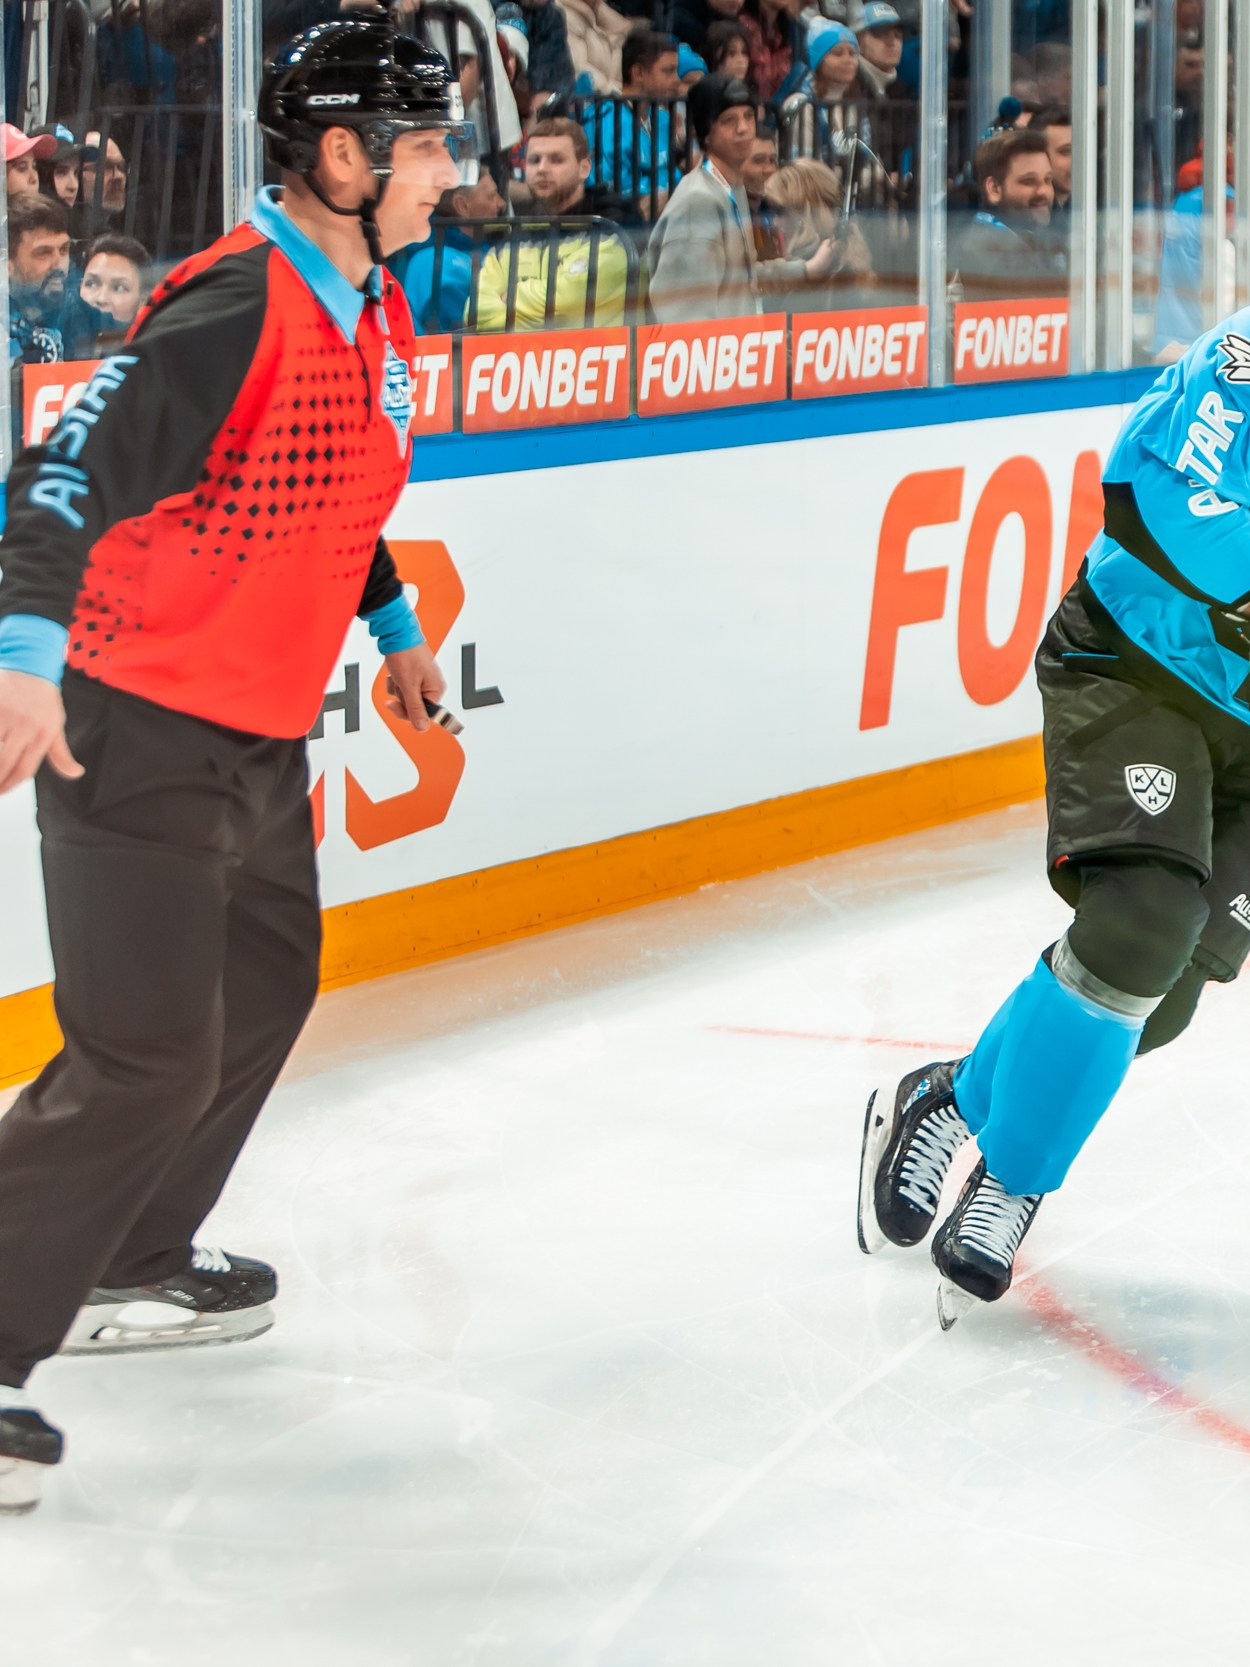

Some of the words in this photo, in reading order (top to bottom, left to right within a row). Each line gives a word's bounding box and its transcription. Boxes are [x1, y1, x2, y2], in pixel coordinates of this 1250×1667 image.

[306, 93, 361, 106] CCM
[640, 330, 784, 400] FONBET
[795, 321, 926, 384] FONBET
[956, 313, 1068, 371] FONBET
[466, 344, 627, 415] FONBET
